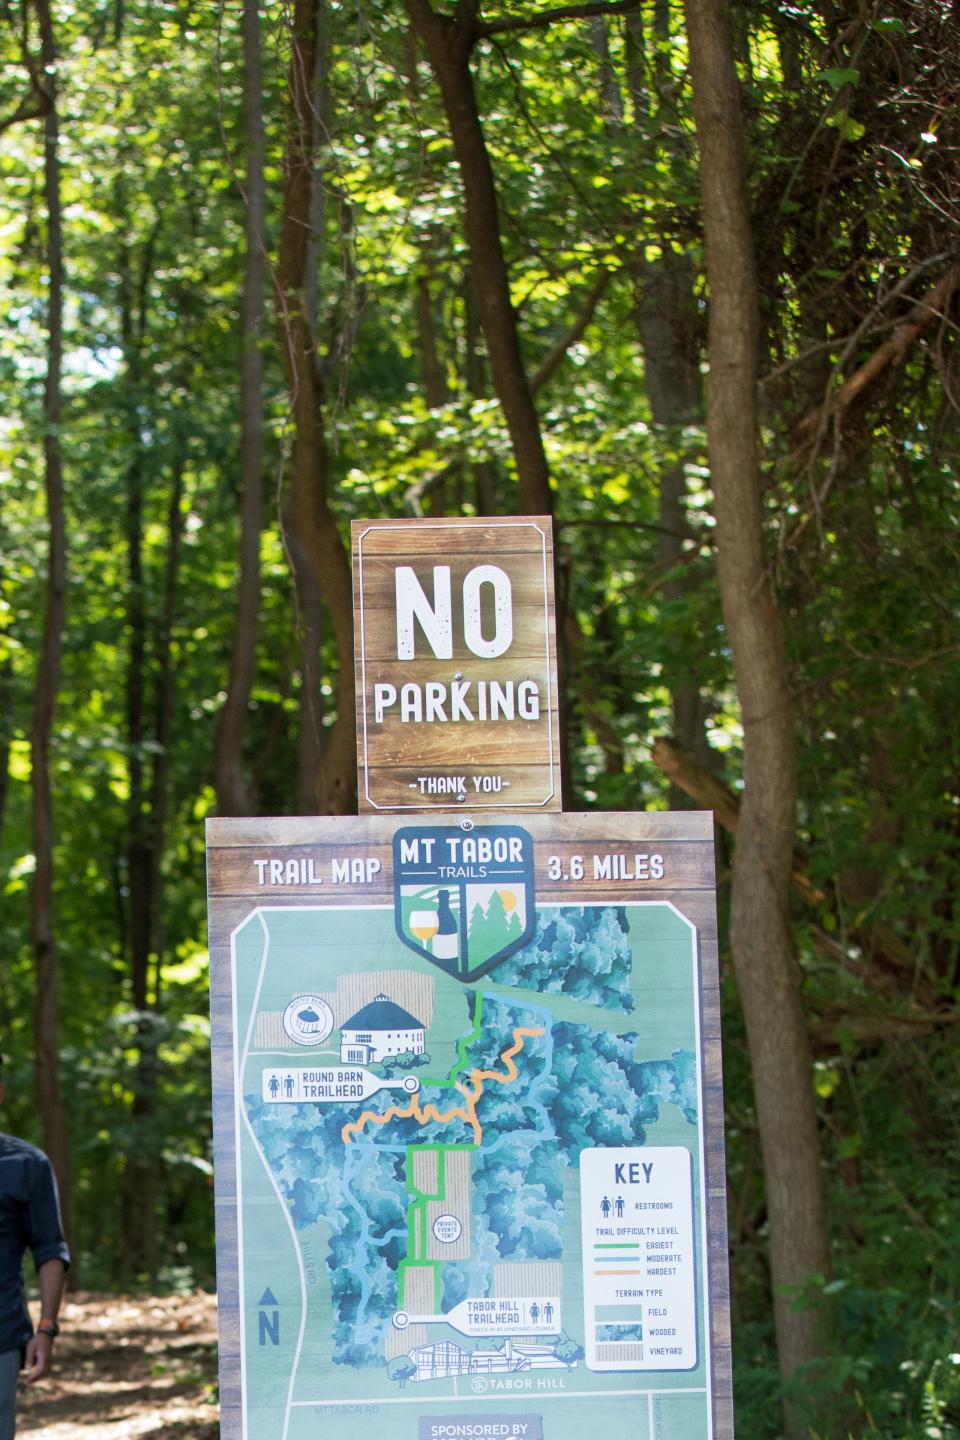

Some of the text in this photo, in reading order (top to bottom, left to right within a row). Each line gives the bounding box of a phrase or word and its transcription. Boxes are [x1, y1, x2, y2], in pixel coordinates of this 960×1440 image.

[394, 564, 514, 661] NO
[374, 680, 540, 724] PARKING
[400, 837, 524, 865] MT TABOR
[254, 857, 382, 885] TRAIL MAP
[438, 866, 487, 879] TRAILS
[548, 854, 665, 881] 3.6 MILES
[303, 1071, 363, 1083] ROUND BARN
[303, 1084, 364, 1097] TRAILHEAD
[615, 1162, 654, 1184] KEY
[635, 1202, 673, 1210] RESTROOMS
[596, 1226, 679, 1236] TRAIL DIFFICULTY LEVEL
[646, 1241, 673, 1250] EASIEST
[647, 1254, 682, 1263] MODERATE
[647, 1267, 677, 1276] HARDEST
[615, 1289, 663, 1298] TERRAIN TYPE
[467, 1301, 520, 1311] TABOR HILL
[648, 1308, 668, 1316] FIELD
[468, 1312, 520, 1324] TRAILHEAD
[258, 1310, 280, 1346] N
[649, 1328, 676, 1336] WOODED
[650, 1347, 683, 1355] VINEYARD
[489, 1378, 566, 1390] TABOR HILL
[431, 1423, 528, 1436] SPONSORED BY
